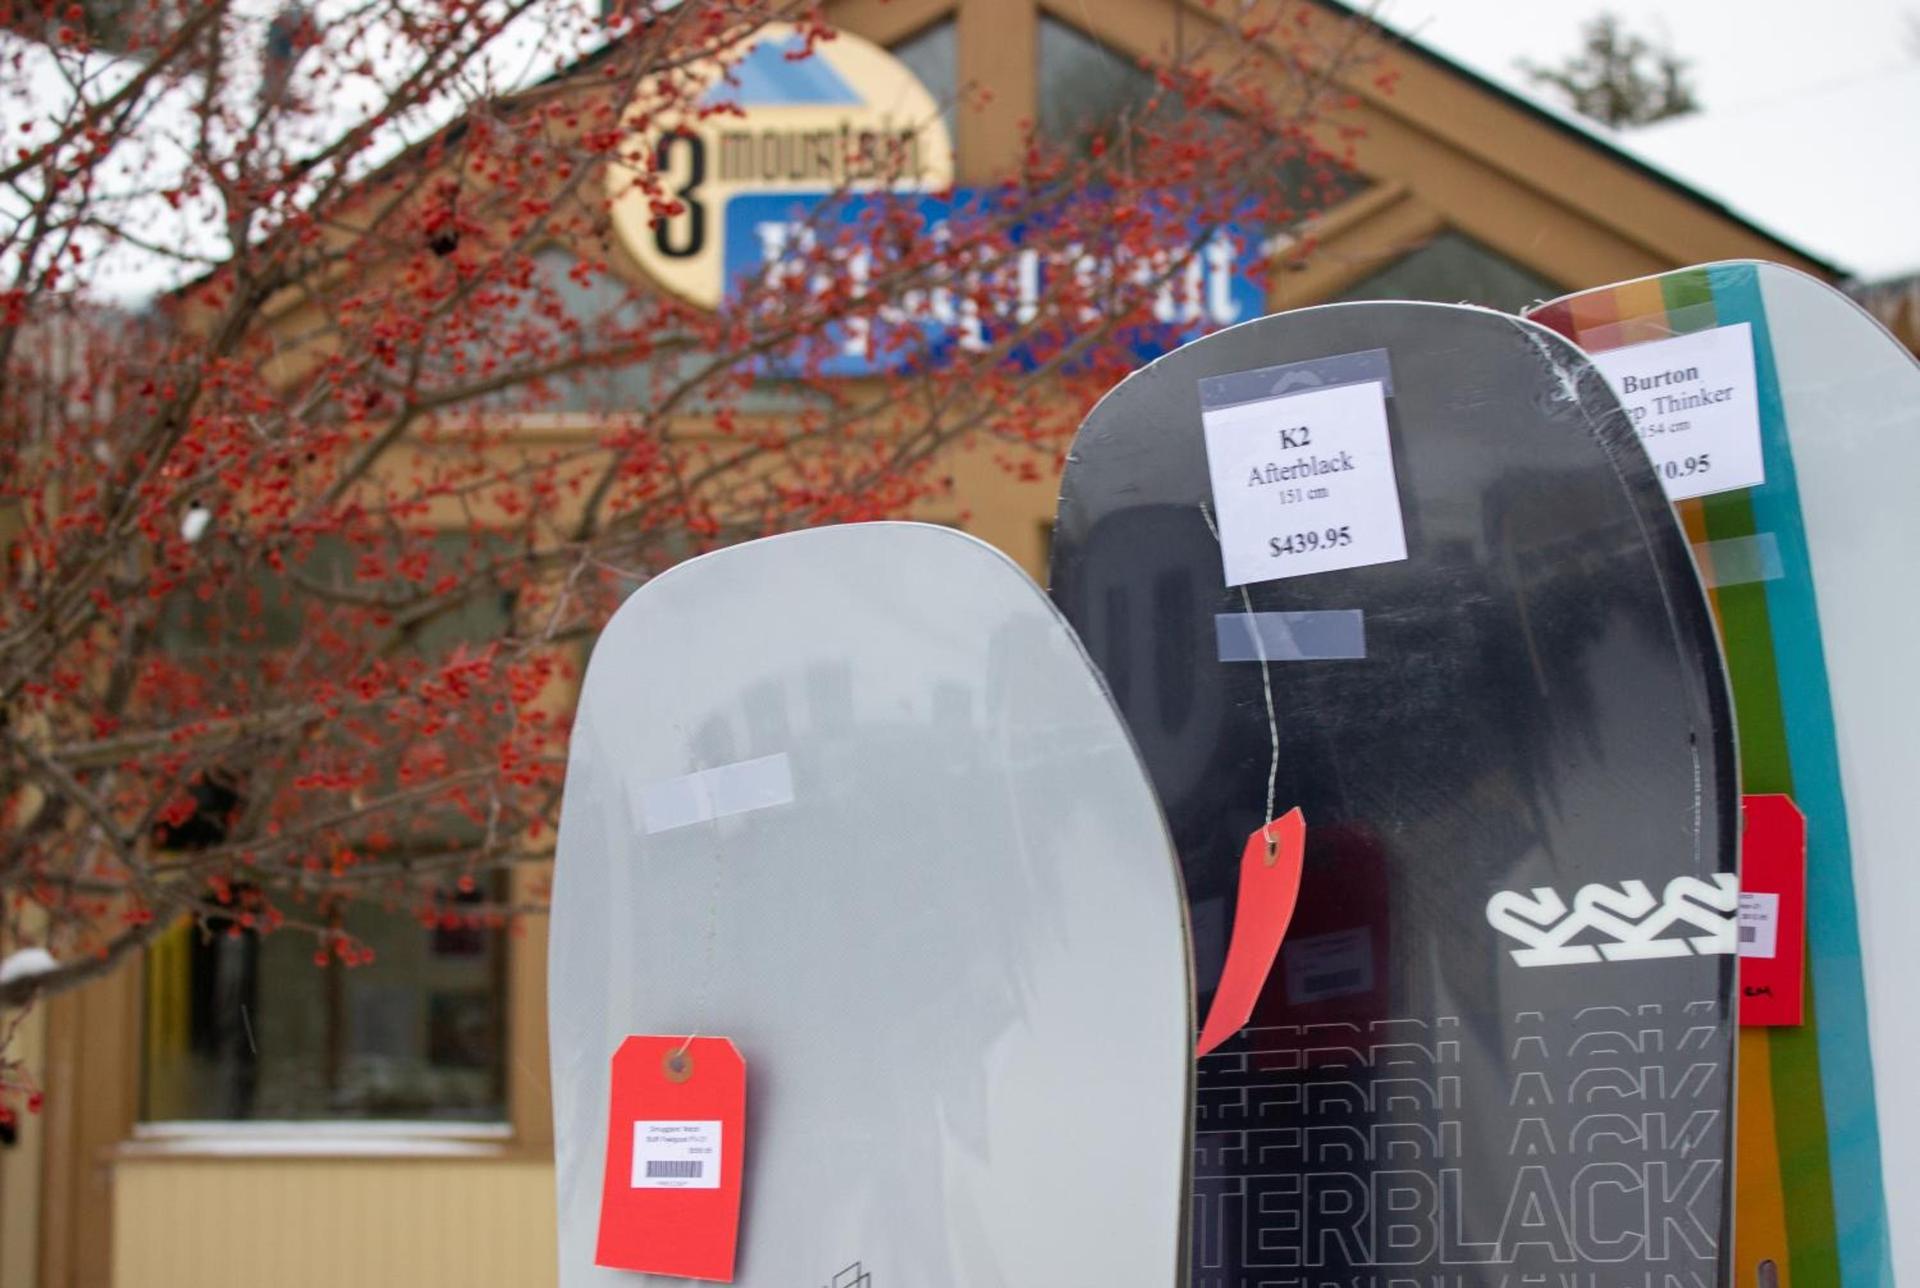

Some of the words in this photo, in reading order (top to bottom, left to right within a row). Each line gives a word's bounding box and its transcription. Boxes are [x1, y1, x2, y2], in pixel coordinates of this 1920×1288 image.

[654, 130, 706, 258] 3
[1623, 367, 1699, 394] Burton
[1652, 386, 1734, 415] Thinker
[1280, 426, 1311, 450] K2
[1669, 421, 1691, 433] cm
[1248, 451, 1355, 487] Afterblack
[1280, 489, 1303, 504] 151
[1307, 487, 1329, 501] cm
[1270, 526, 1353, 557] $439.95
